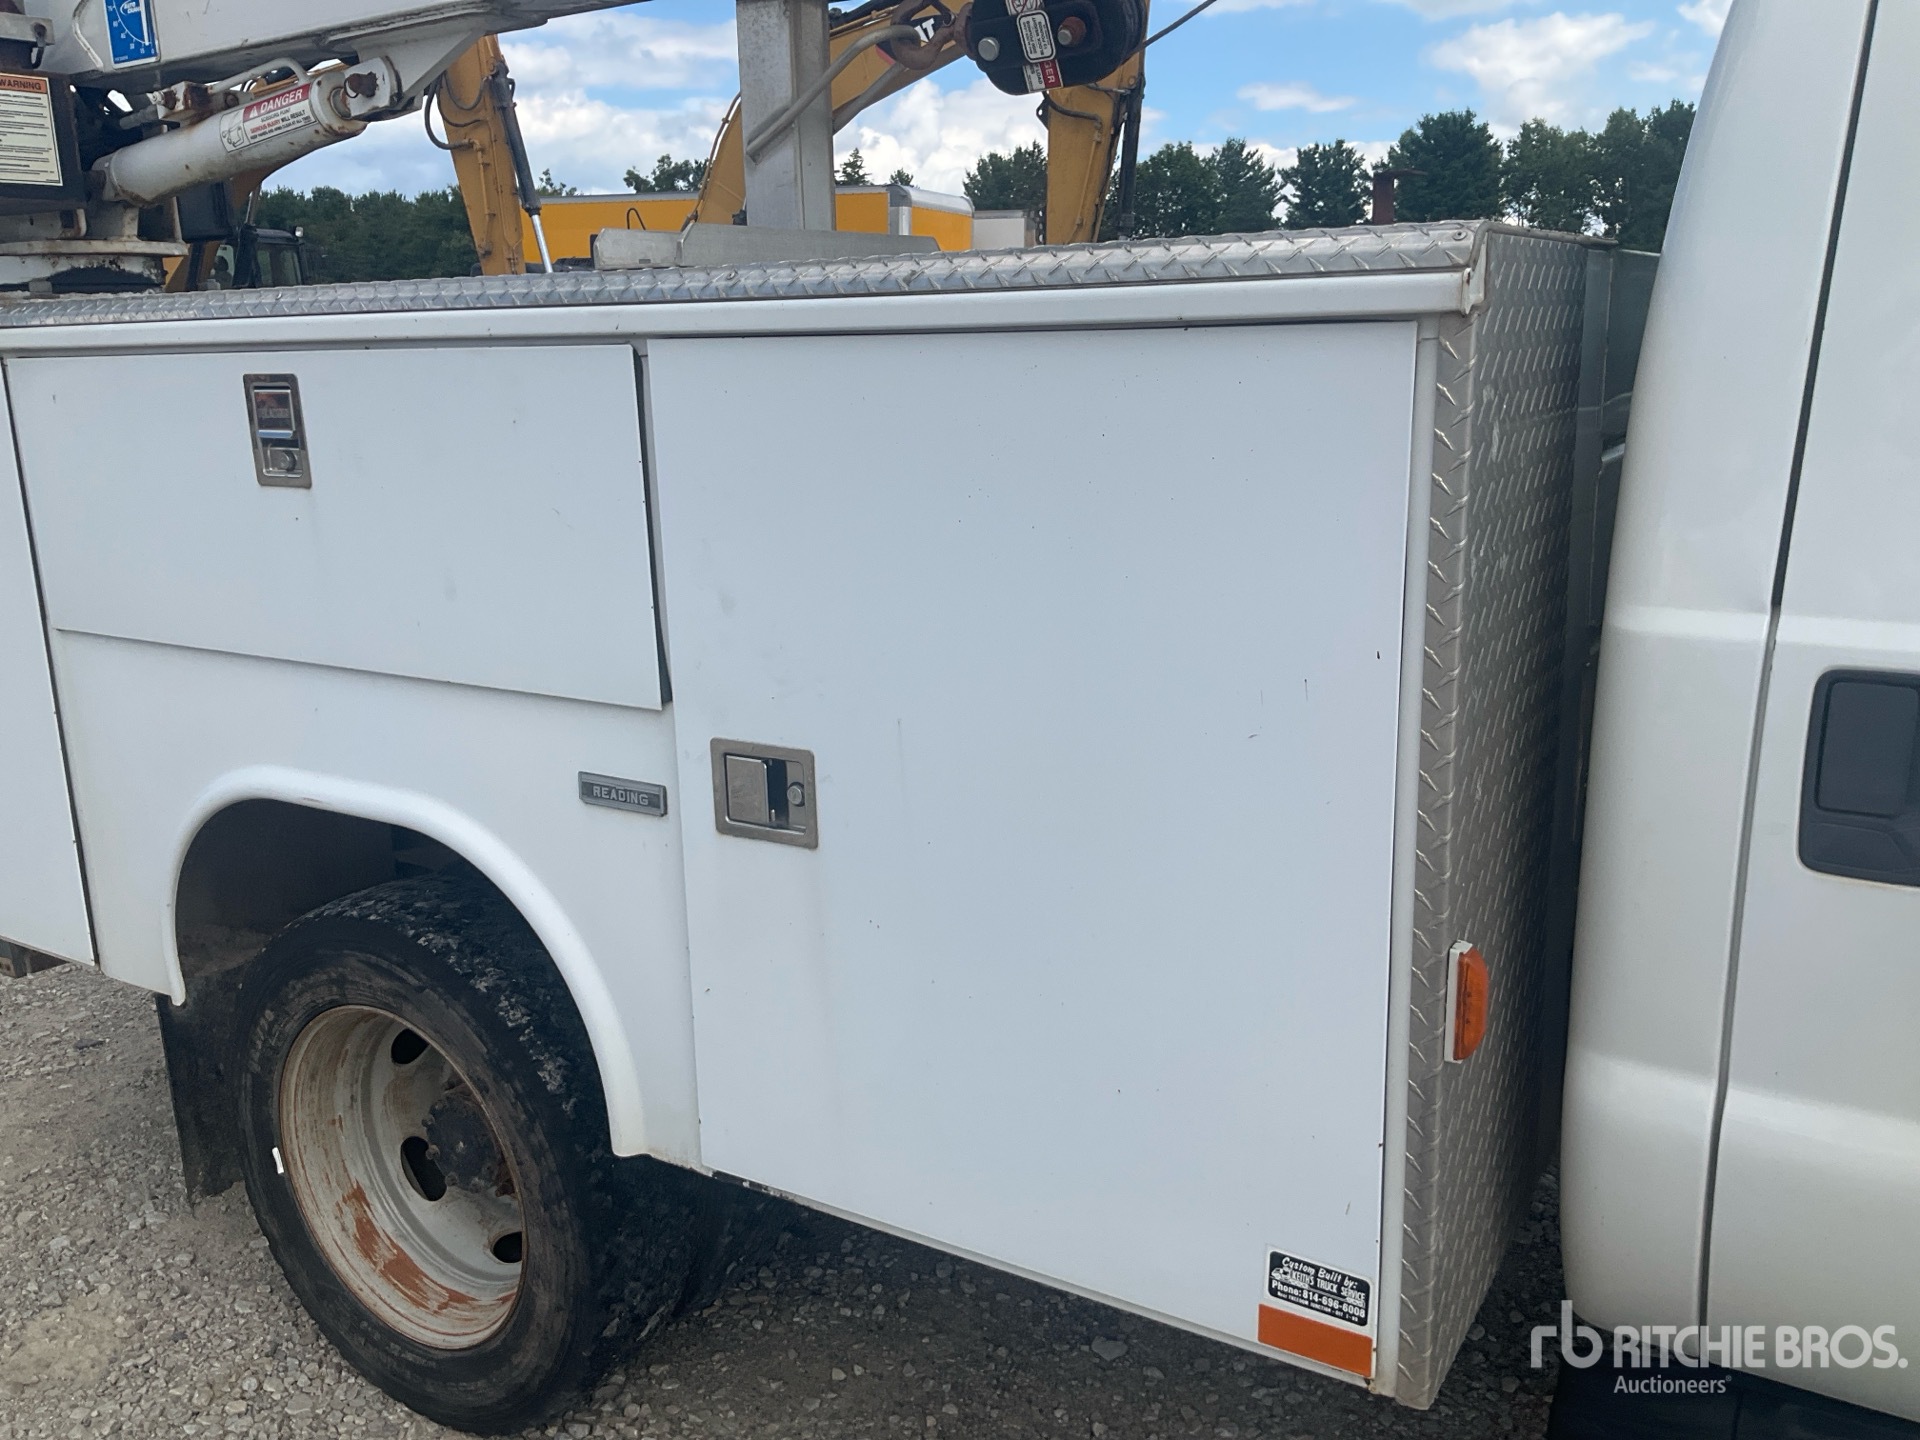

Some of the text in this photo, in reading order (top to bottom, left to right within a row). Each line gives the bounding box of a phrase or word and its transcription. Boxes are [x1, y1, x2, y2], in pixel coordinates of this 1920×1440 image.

[260, 89, 303, 113] DANGER
[280, 115, 291, 123] WILL
[290, 109, 306, 119] RESULT
[593, 785, 649, 806] READING
[1282, 1256, 1358, 1290] Custom Built by:
[1292, 1270, 1366, 1300] KEITH'S TRUCK SERVICE
